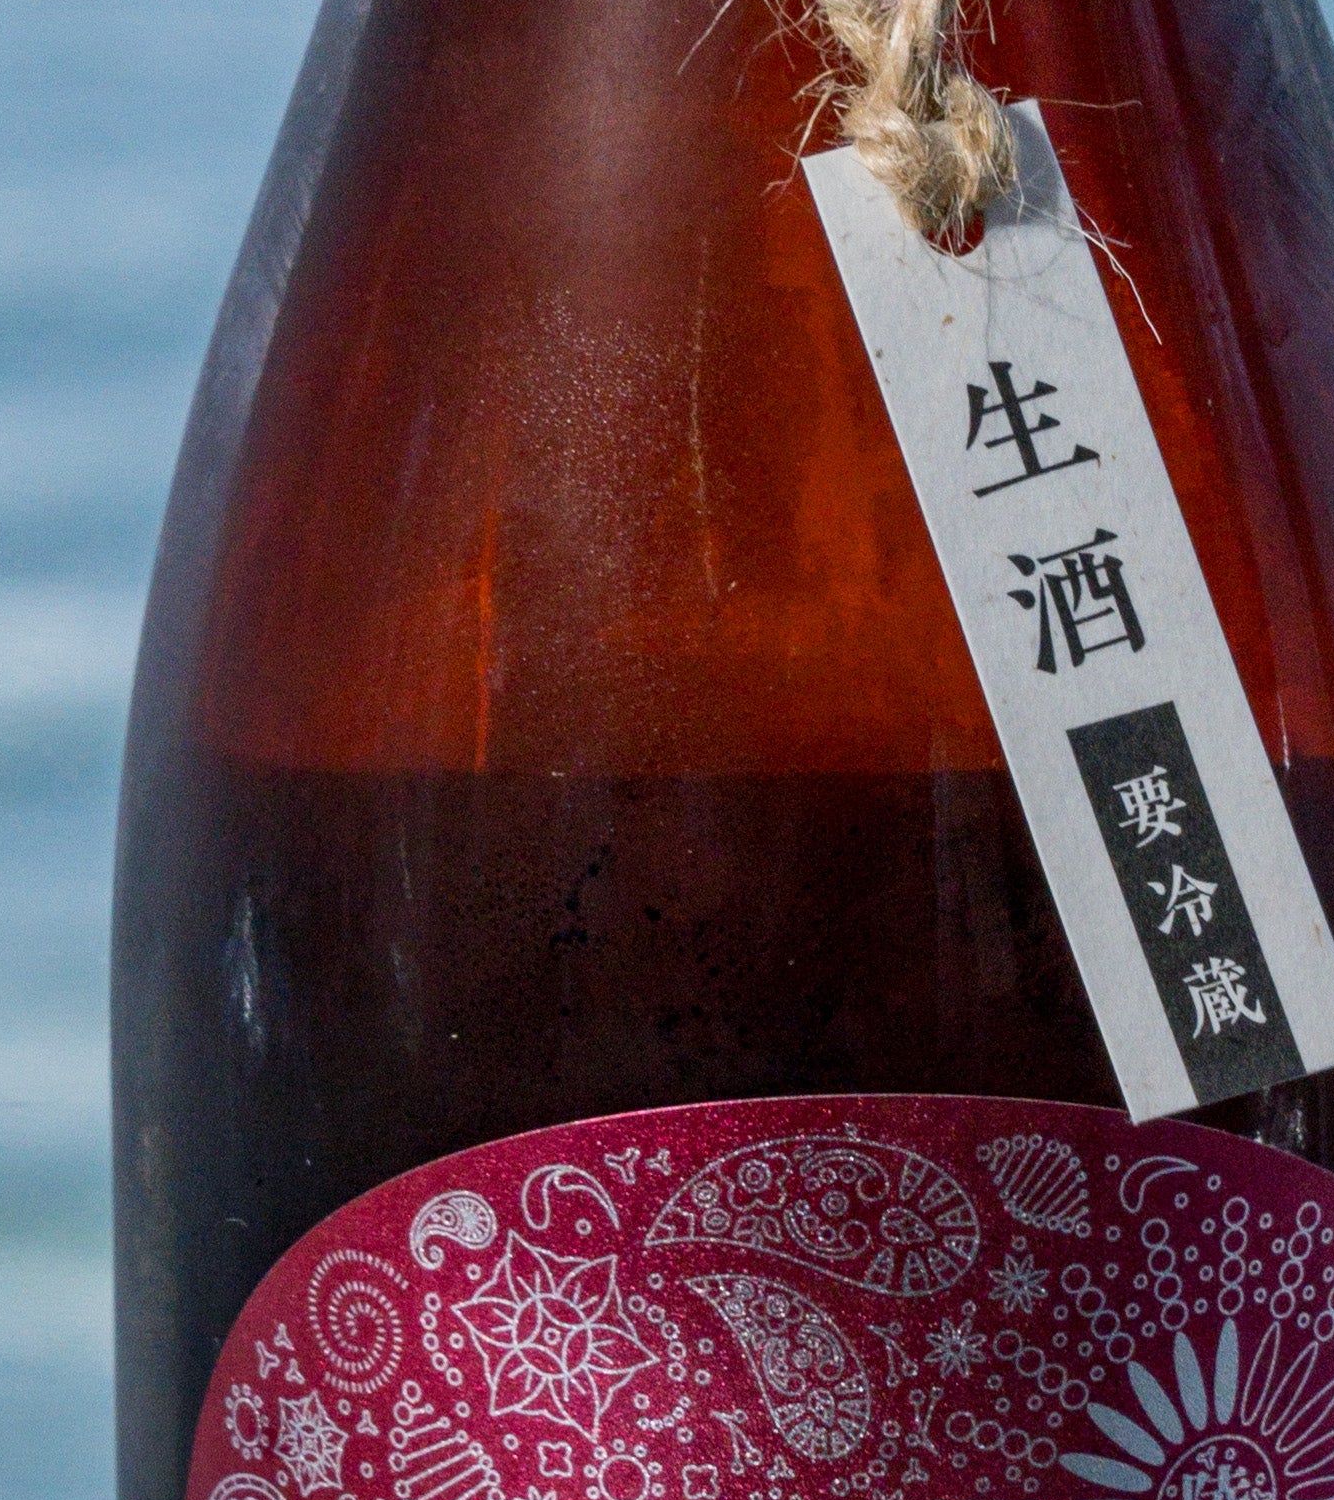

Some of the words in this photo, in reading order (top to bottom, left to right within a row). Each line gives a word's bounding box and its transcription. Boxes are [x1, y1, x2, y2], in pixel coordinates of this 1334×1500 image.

[964, 360, 1147, 675] 生酒
[1112, 764, 1267, 1041] 要冷蔵
